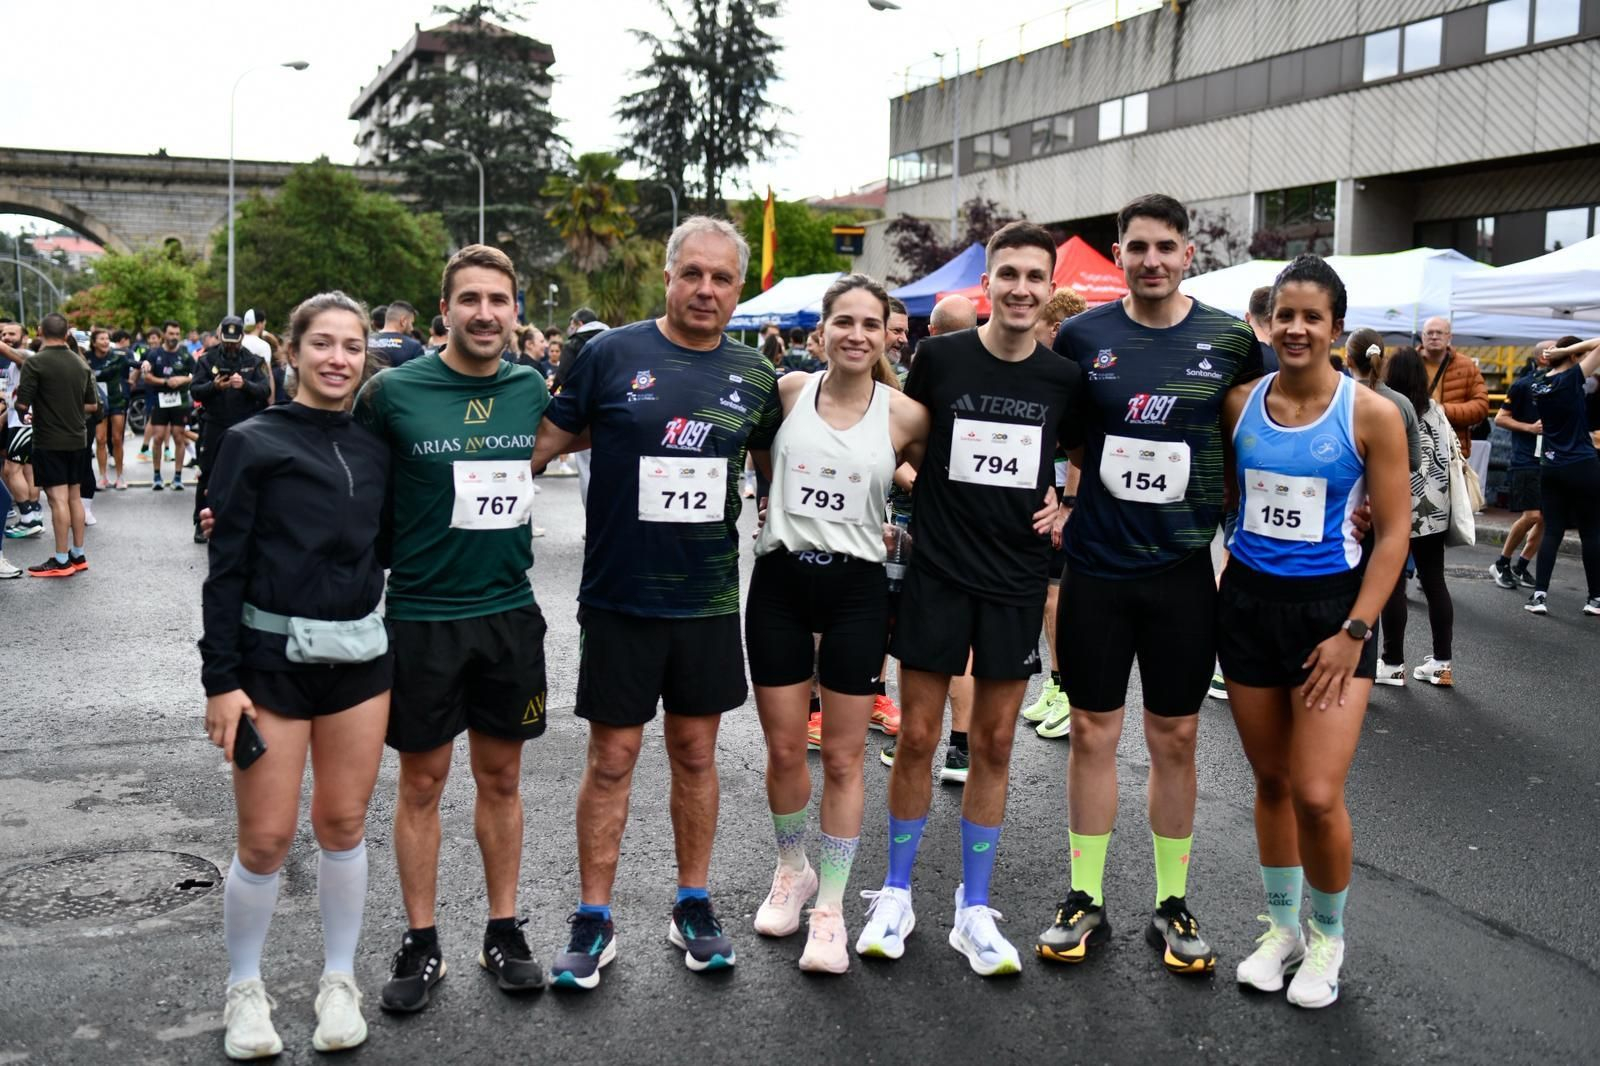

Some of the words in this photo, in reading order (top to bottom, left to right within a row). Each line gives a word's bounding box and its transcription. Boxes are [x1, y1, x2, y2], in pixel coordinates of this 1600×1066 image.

[1186, 368, 1222, 379] Santander
[980, 395, 1049, 420] TERREX
[412, 438, 461, 455] ARIAS
[973, 454, 1018, 476] 794
[1121, 470, 1167, 492] 154
[476, 496, 518, 515] 767
[661, 491, 707, 509] 712
[800, 486, 845, 511] 793
[1261, 505, 1301, 528] 155
